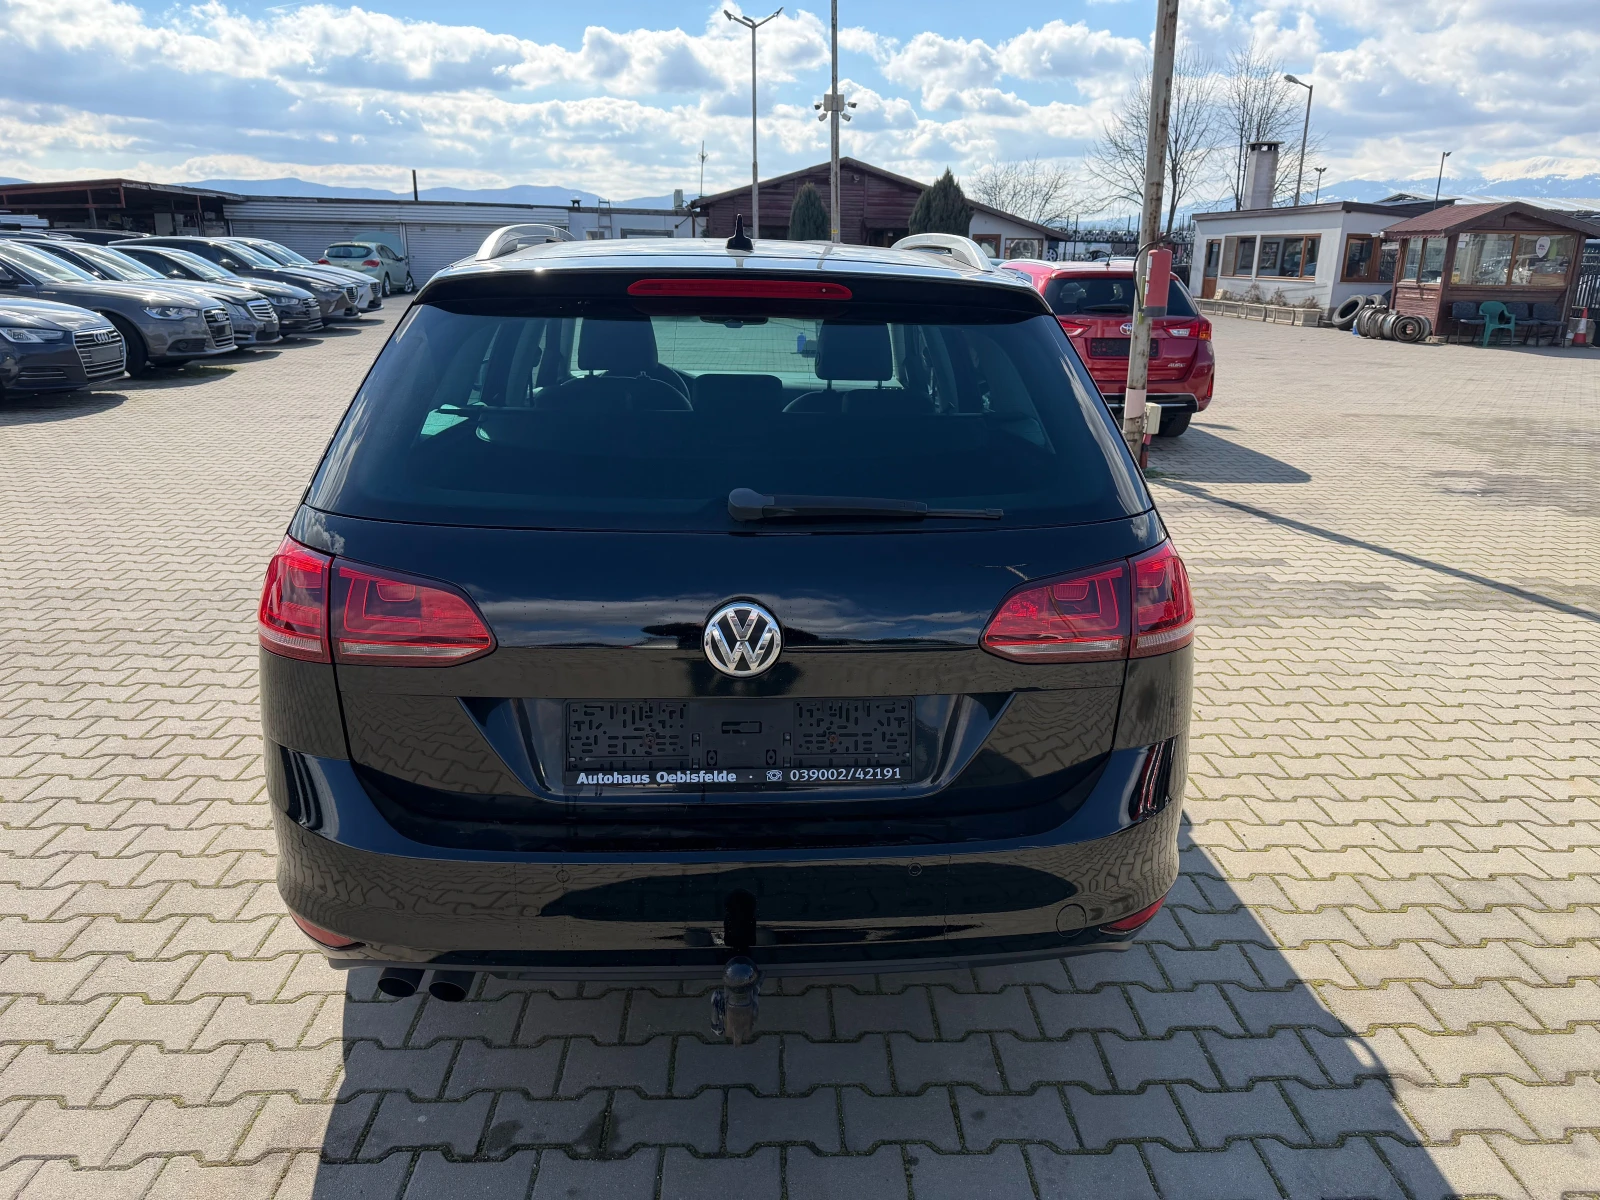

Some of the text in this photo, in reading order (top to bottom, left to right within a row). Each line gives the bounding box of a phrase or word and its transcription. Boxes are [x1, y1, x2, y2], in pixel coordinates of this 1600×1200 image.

[576, 767, 901, 785] Autohaus Oebisfelde 039002/42191
